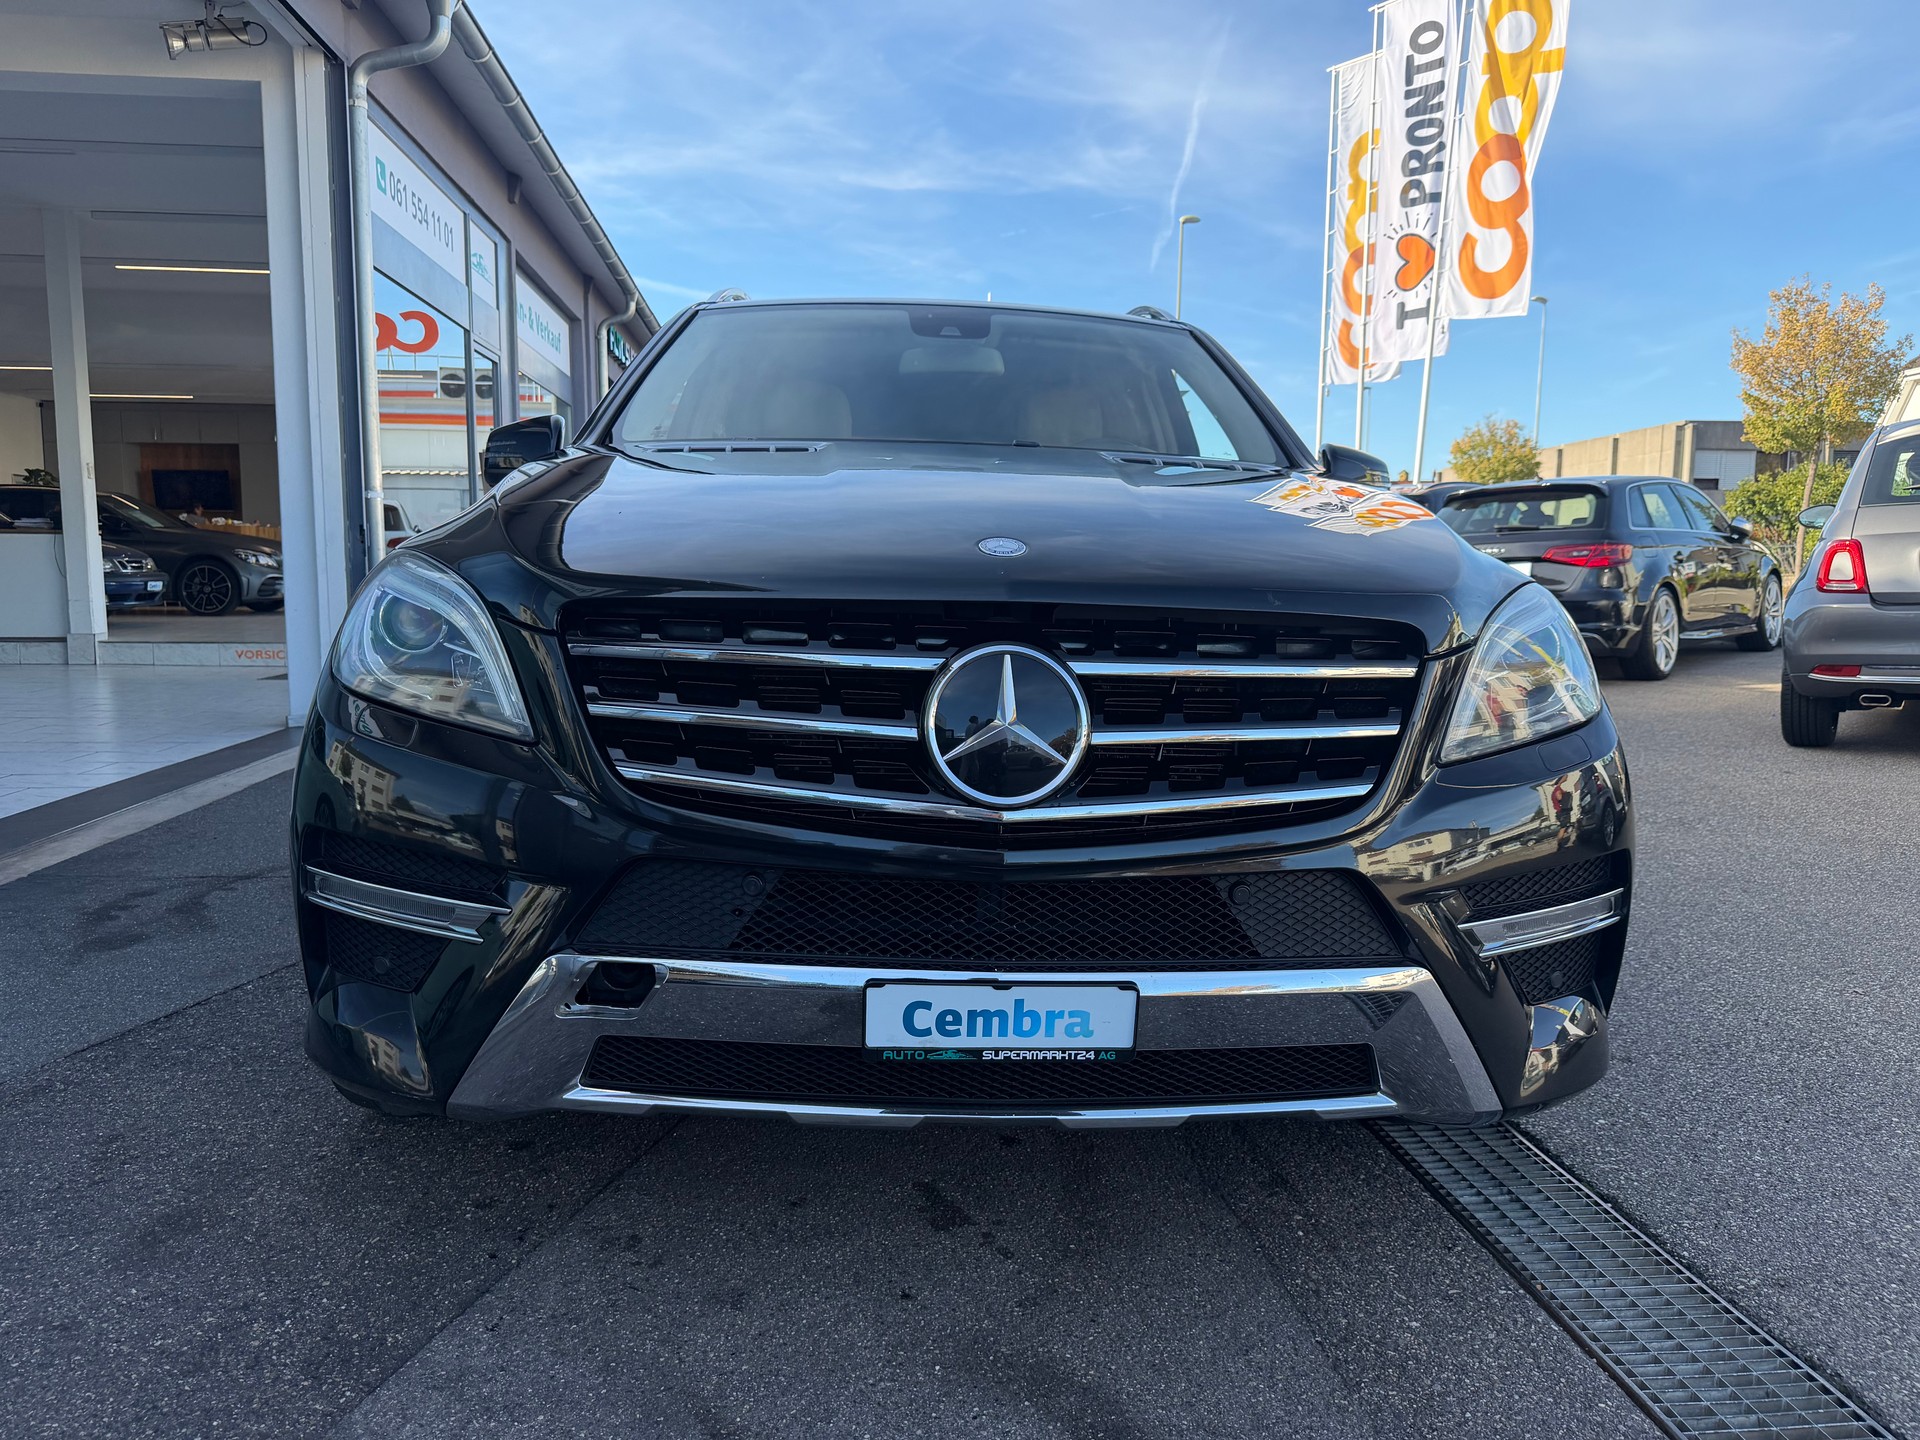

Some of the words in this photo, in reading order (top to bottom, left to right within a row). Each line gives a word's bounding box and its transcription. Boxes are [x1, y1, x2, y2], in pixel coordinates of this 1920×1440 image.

[1400, 20, 1446, 208] PRONTO
[389, 170, 408, 213] 061
[411, 190, 429, 231] 554
[431, 210, 442, 242] 11
[444, 221, 454, 252] 01
[534, 311, 561, 354] Verkauf
[1396, 296, 1432, 330] I
[235, 650, 286, 660] VORSIC
[902, 998, 1094, 1038] Cembra
[883, 1050, 924, 1060] AUTO
[982, 1050, 1095, 1060] SUPERMARKT24
[1098, 1050, 1116, 1060] AG
